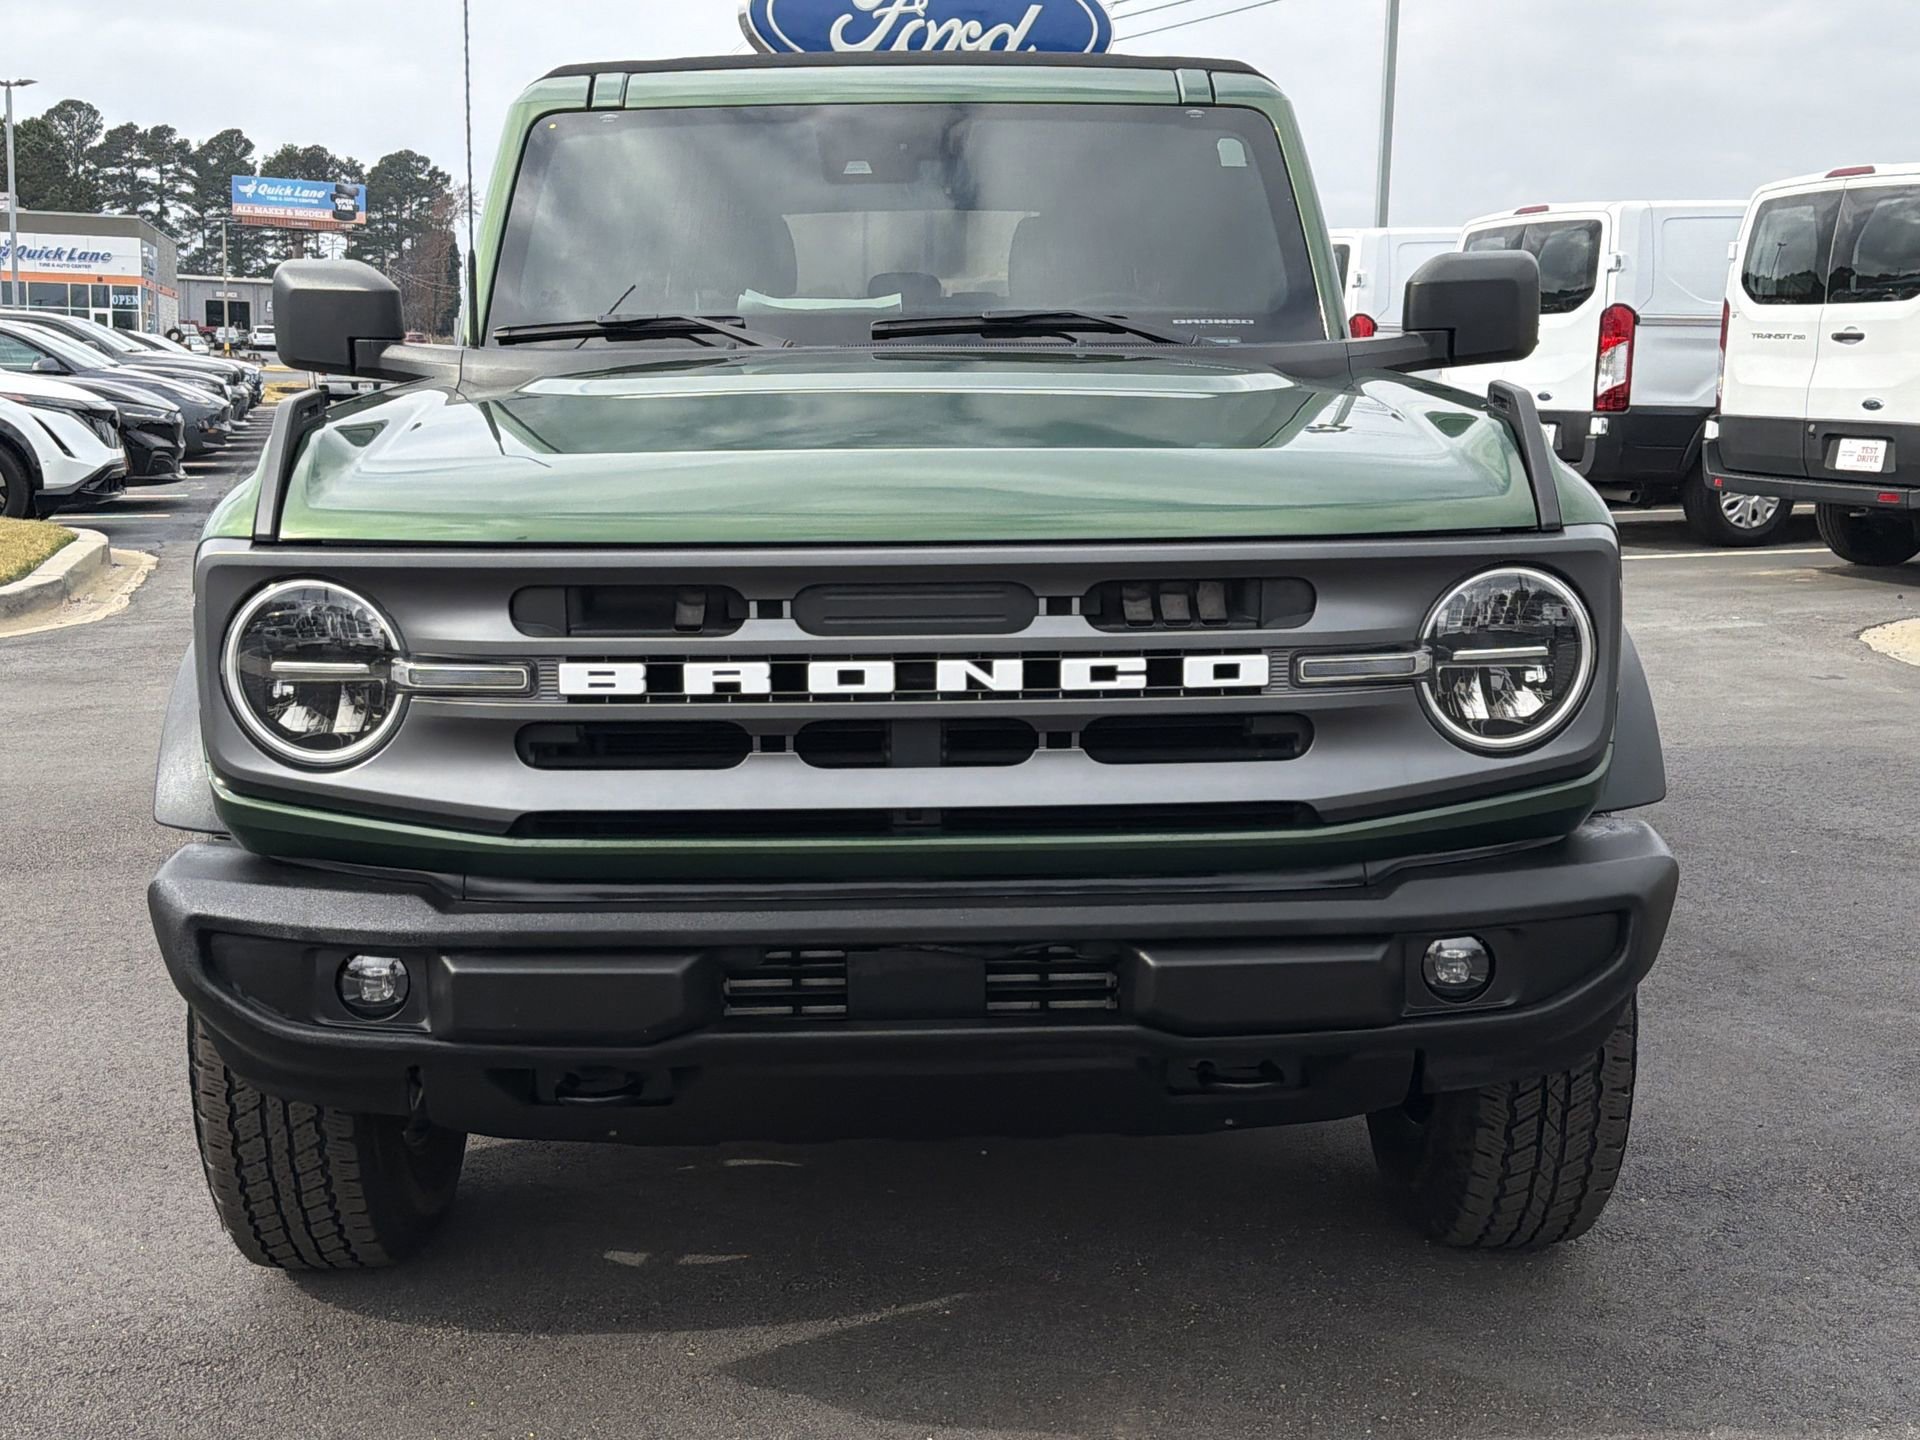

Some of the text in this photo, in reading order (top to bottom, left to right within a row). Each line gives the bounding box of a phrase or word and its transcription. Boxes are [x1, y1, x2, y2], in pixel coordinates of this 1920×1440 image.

[829, 0, 1043, 51] Ford
[258, 183, 326, 199] Quick Lane
[236, 205, 253, 213] ALL
[254, 206, 285, 216] MAKES
[294, 209, 330, 219] MODELS
[17, 245, 113, 264] Quick Lane
[112, 294, 138, 306] OPEN
[1751, 332, 1793, 340] TRANSIT
[1861, 446, 1878, 455] TEST
[1856, 454, 1880, 463] DRIVE
[558, 654, 1270, 695] BRONCO
